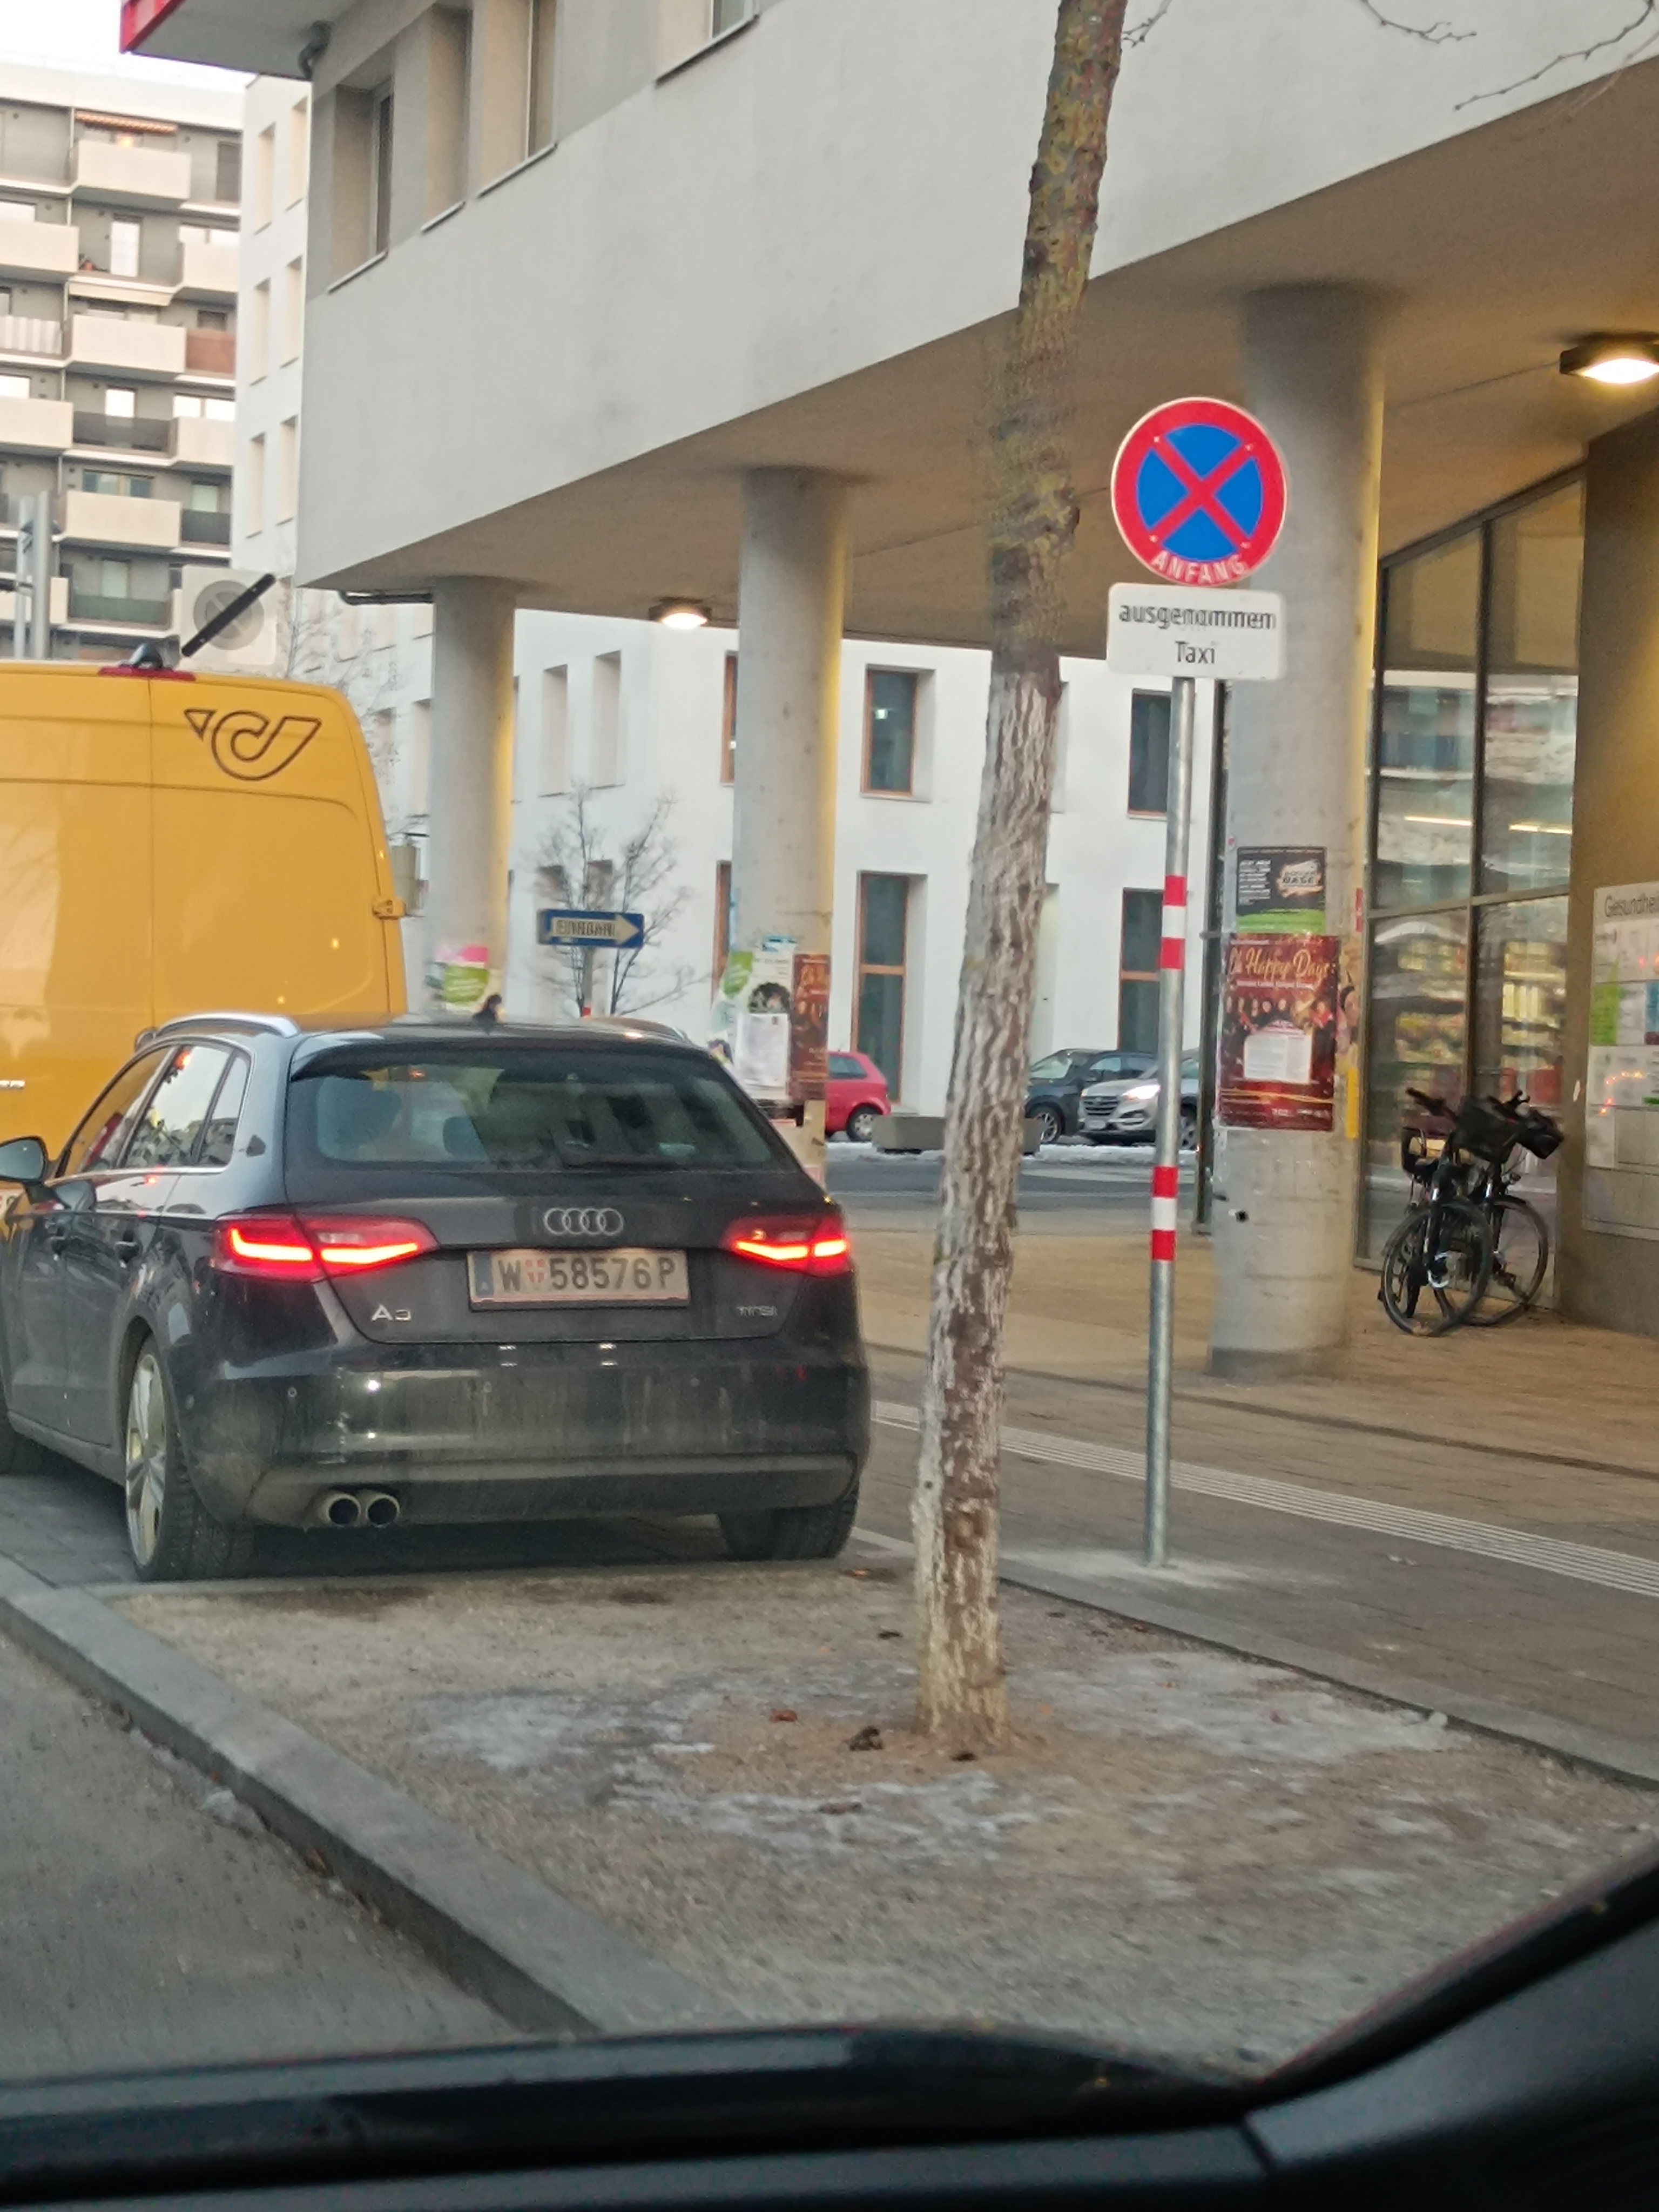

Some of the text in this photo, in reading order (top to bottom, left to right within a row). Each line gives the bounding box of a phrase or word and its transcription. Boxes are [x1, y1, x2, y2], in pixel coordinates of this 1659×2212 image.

[1151, 550, 1249, 584] ANFANG
[1119, 604, 1276, 630] ausgenommen
[1175, 639, 1215, 664] Taxi
[1245, 947, 1291, 981] Happy
[1293, 948, 1331, 989] Days
[498, 1259, 522, 1292] W
[372, 1303, 411, 1321] A3
